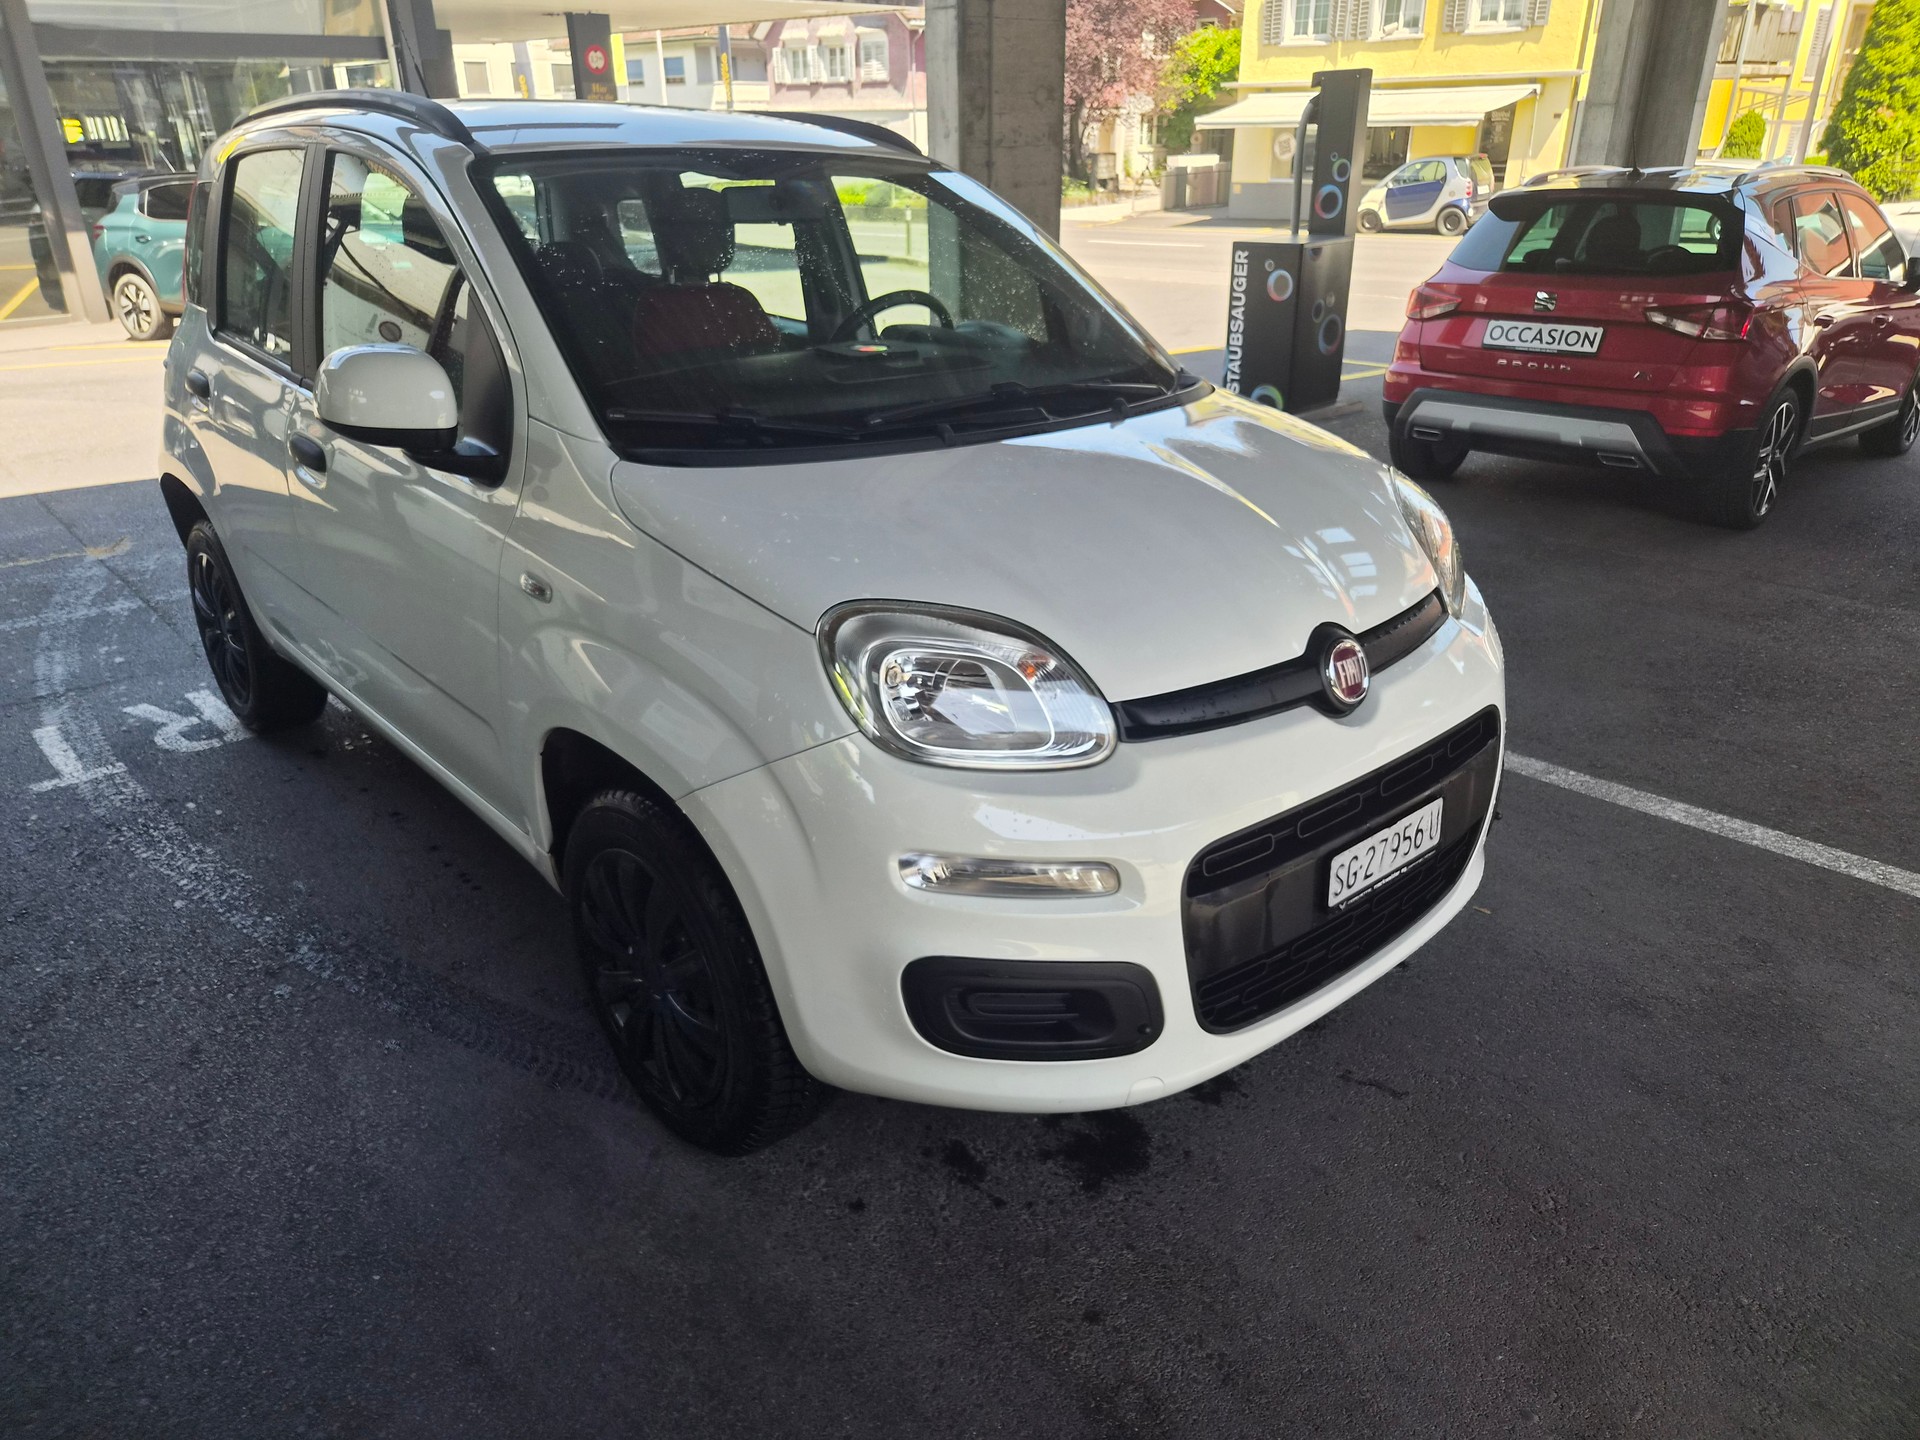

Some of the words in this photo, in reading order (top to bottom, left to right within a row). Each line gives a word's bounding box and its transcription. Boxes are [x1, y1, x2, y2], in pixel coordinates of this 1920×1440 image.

[1226, 250, 1249, 394] STAUBSAUGER
[1489, 325, 1598, 349] OCCASION
[1336, 655, 1364, 689] FIAT
